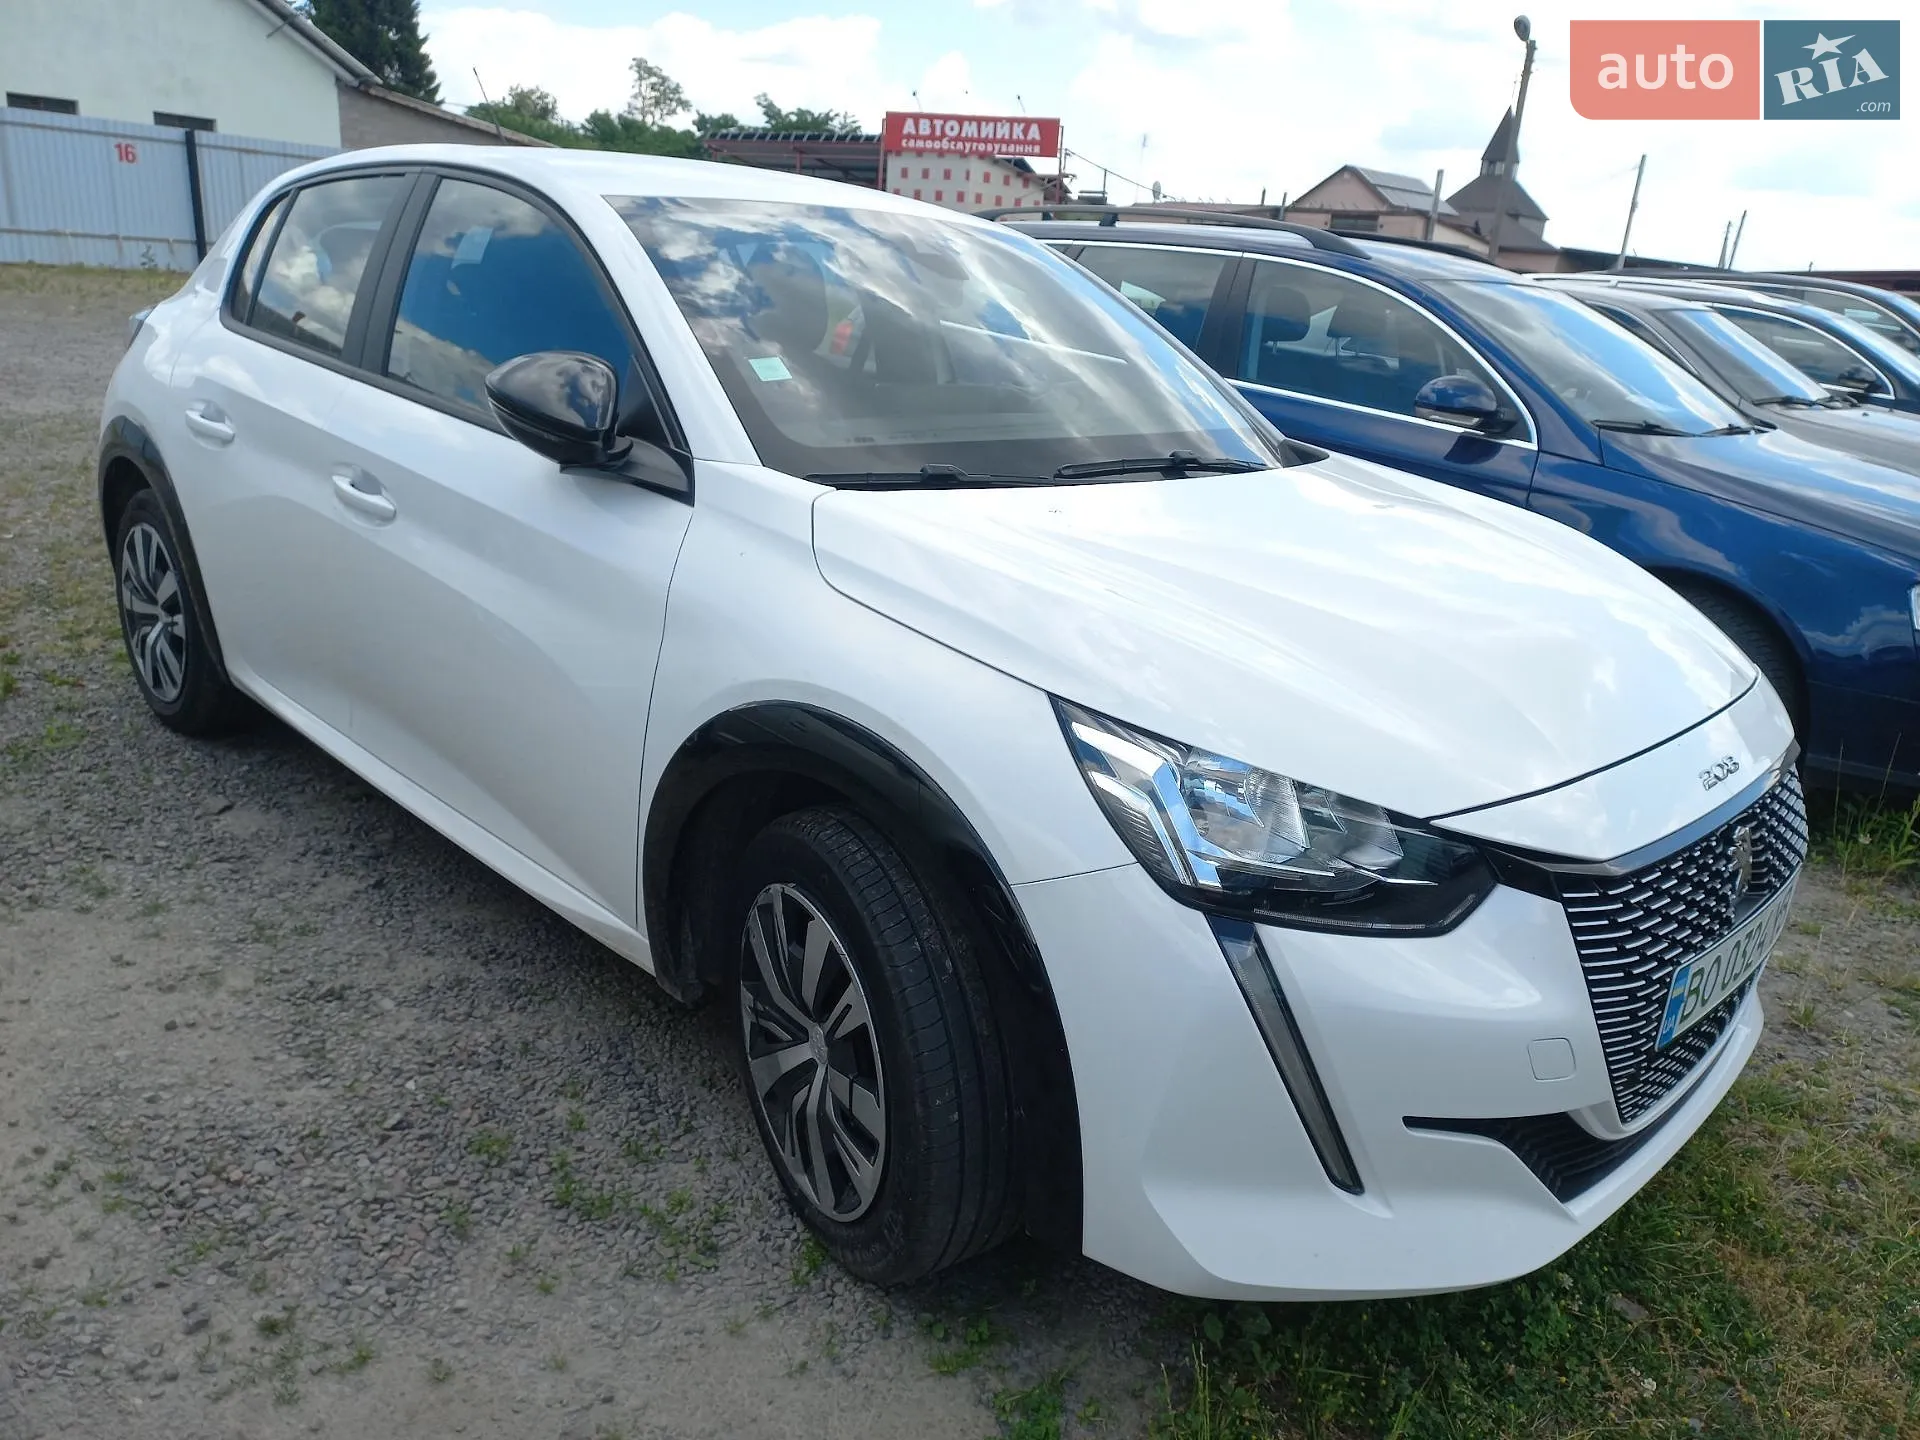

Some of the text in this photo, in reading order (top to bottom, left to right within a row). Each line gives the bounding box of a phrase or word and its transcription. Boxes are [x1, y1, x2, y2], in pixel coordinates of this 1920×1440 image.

[902, 117, 1041, 141] АВТОМИЙКА
[113, 143, 137, 165] 16
[901, 137, 1041, 155] самообслуговування
[1699, 755, 1739, 791] 208
[1678, 954, 1722, 1026] BO
